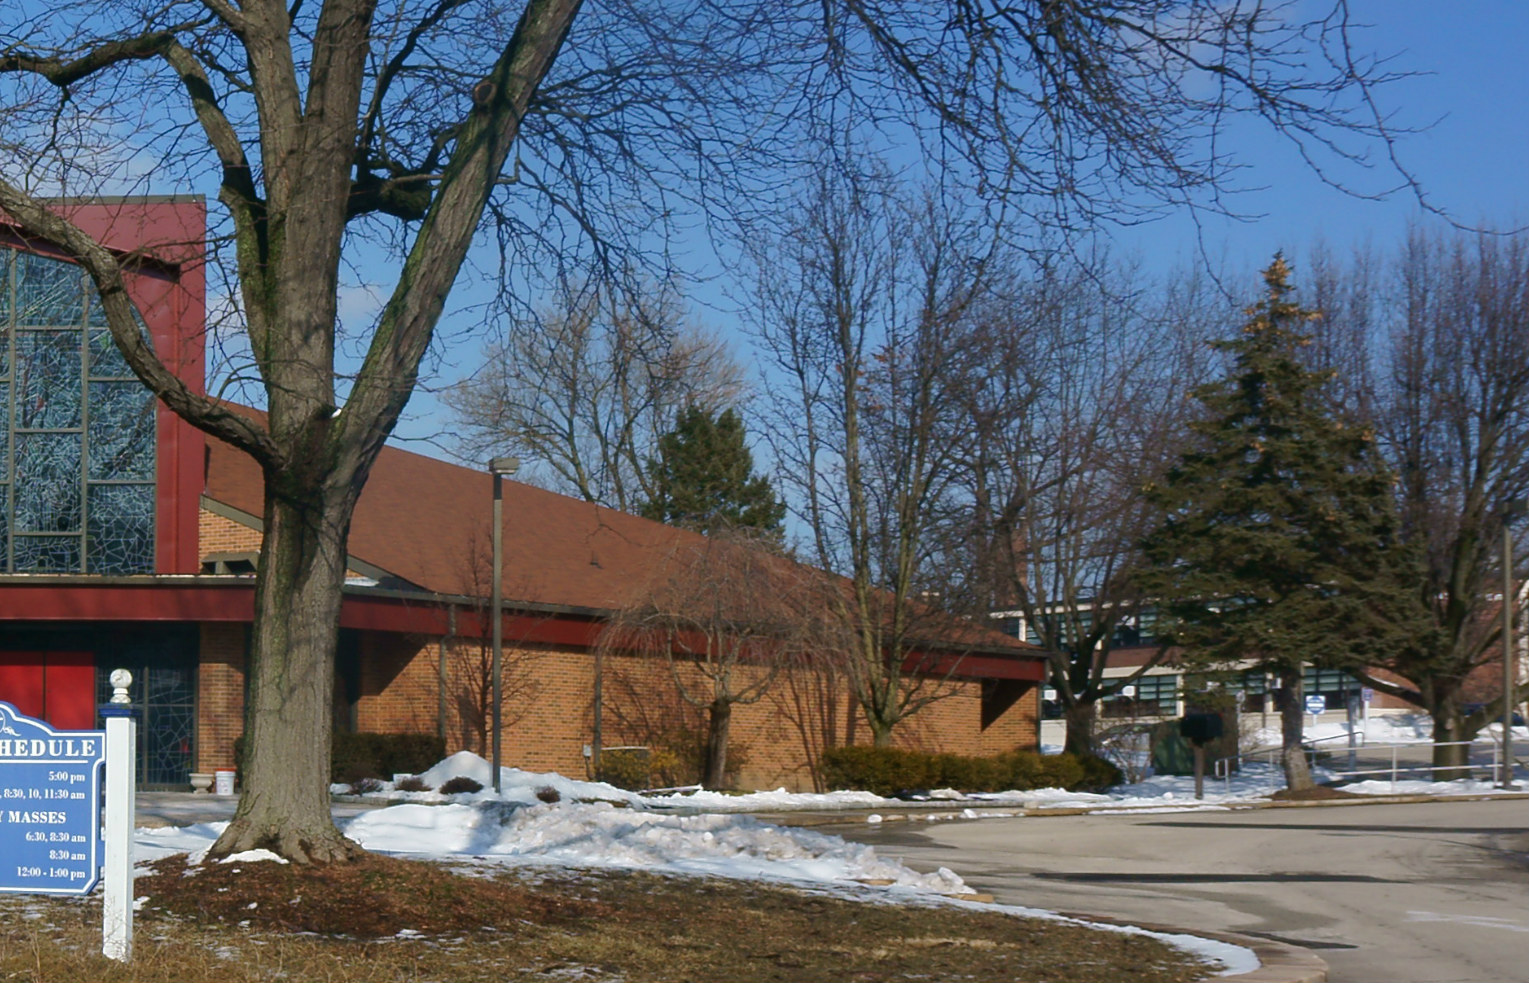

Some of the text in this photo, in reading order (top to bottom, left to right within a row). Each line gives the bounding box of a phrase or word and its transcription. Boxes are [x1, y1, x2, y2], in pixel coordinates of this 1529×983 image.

[48, 770, 69, 782] 5:00
[69, 773, 86, 785] pm
[44, 788, 70, 800] 11:30
[70, 791, 86, 800] am
[7, 810, 67, 825] MASSES
[49, 831, 70, 842] 8:30
[70, 834, 87, 843] am
[48, 849, 70, 860] 8:30
[70, 853, 86, 861] am
[17, 866, 42, 878] 12:00
[49, 867, 69, 878] 1:00
[70, 870, 87, 881] pm
